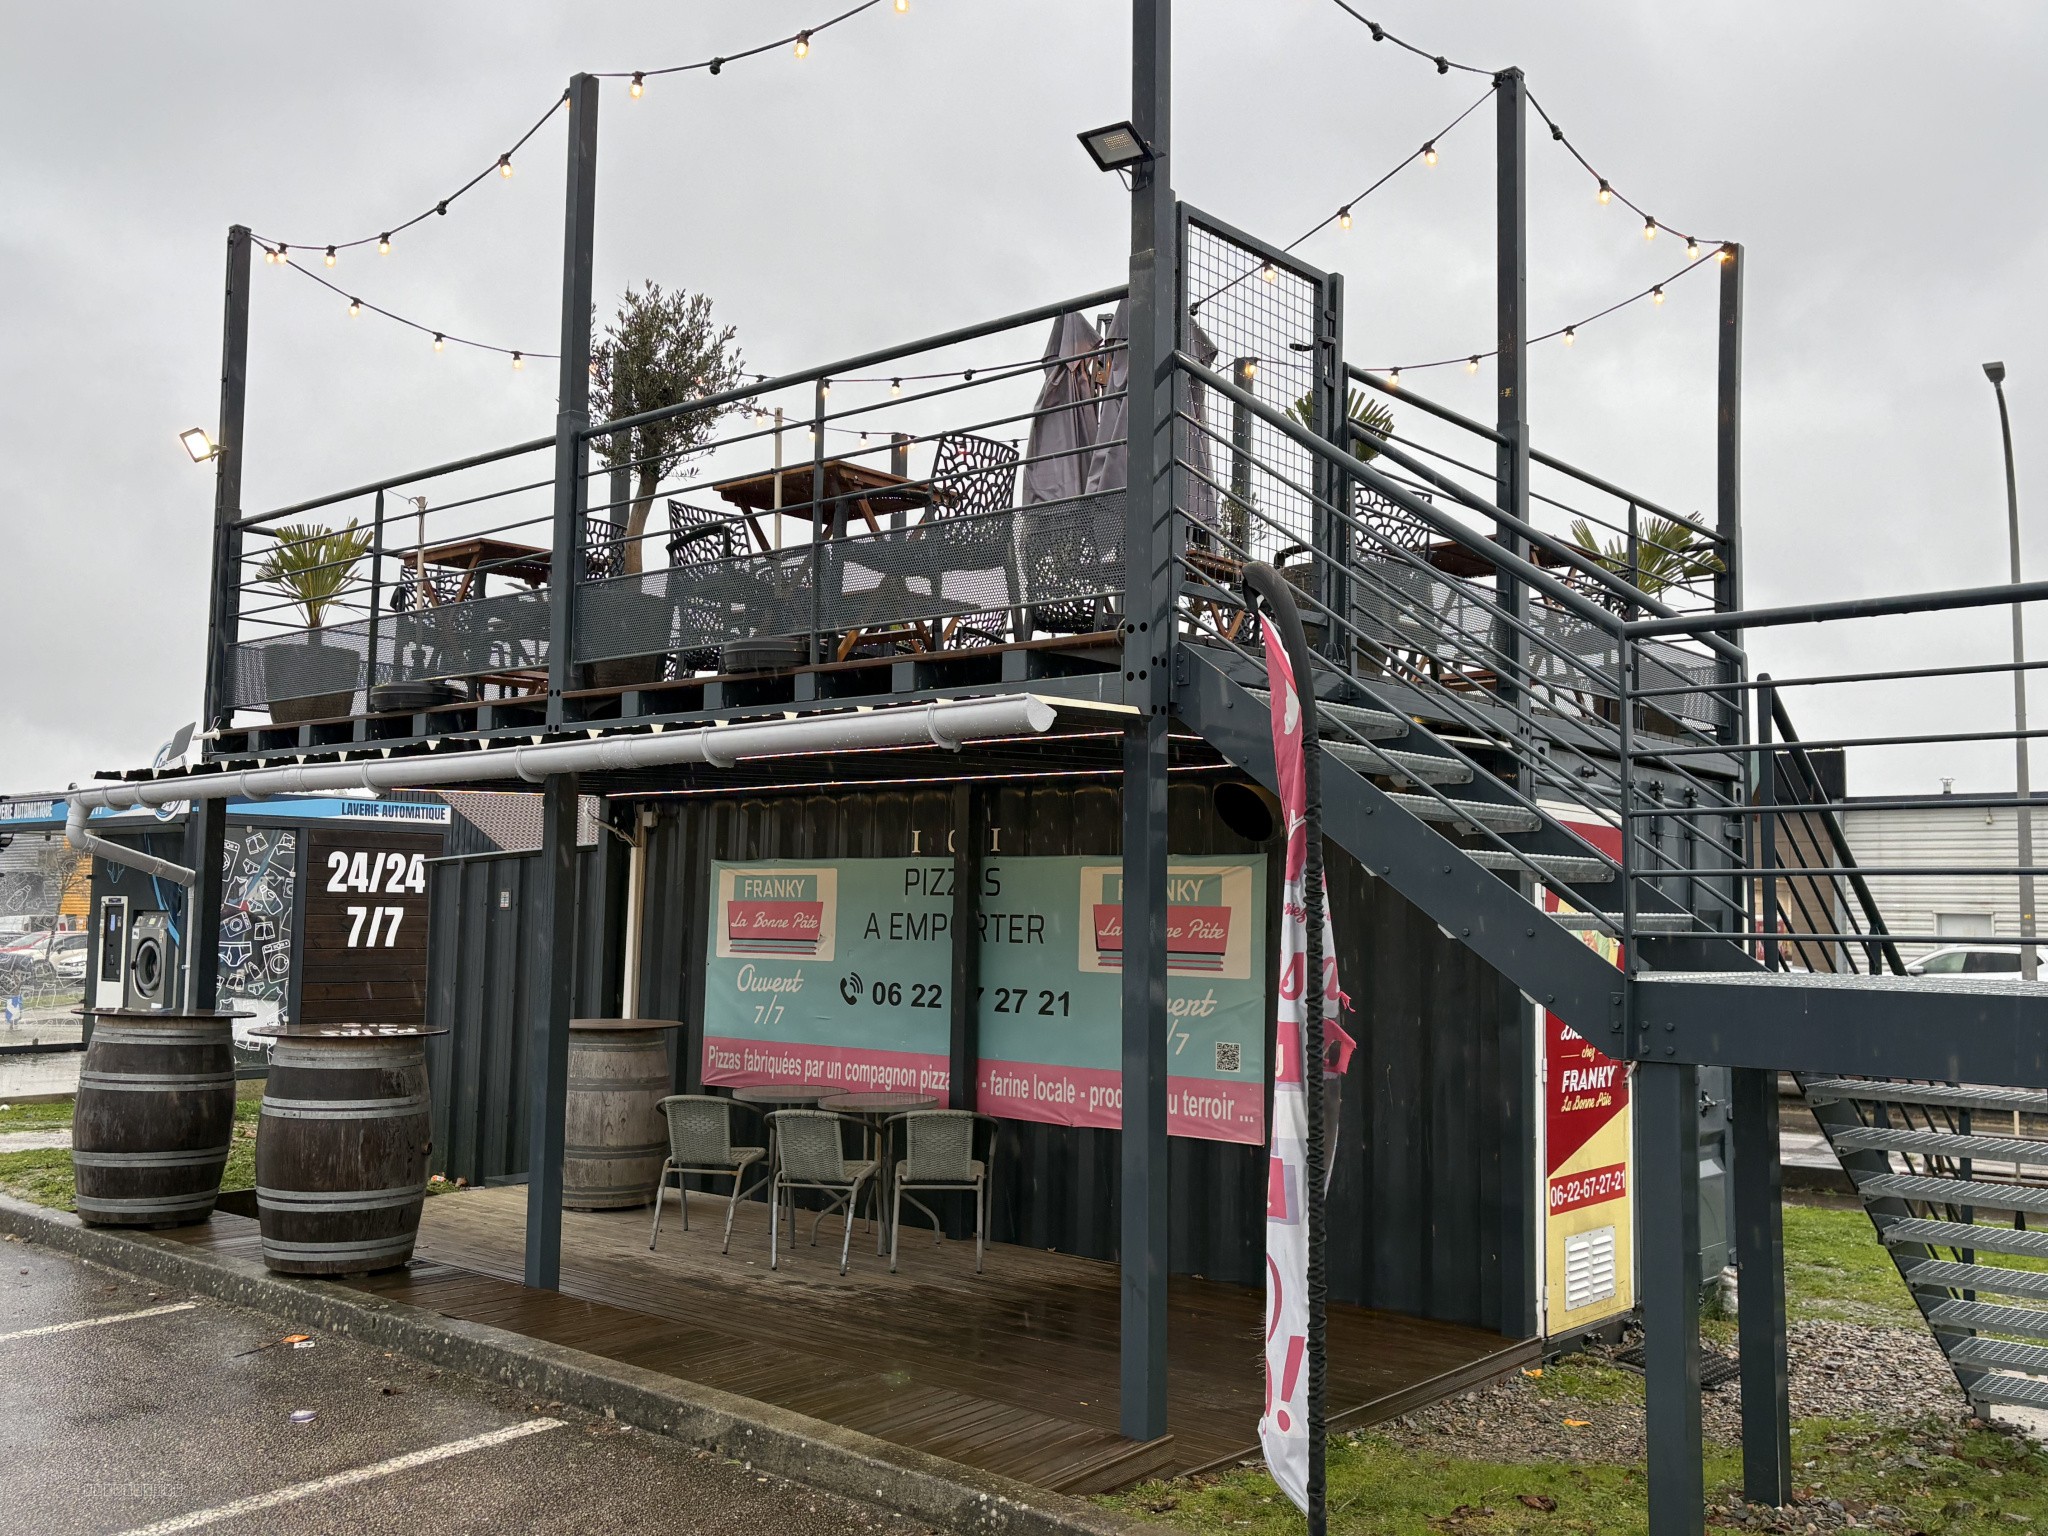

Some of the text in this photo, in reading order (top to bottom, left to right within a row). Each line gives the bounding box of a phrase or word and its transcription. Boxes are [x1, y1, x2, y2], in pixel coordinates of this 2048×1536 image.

[14, 801, 53, 818] AUTOMATIQUE
[341, 802, 446, 820] LAVERIE AUTOMATIQUE
[326, 850, 426, 894] 24/24
[904, 867, 1001, 897] PIZS
[744, 879, 805, 898] FRANKY
[347, 906, 404, 948] 7/7
[731, 911, 819, 929] La Bonne Pâte
[863, 912, 1045, 944] A EMPRTER
[1098, 917, 1122, 936] La
[1188, 919, 1225, 939] Pâte
[737, 963, 804, 993] Ouvert
[754, 994, 785, 1025] 7/7
[872, 981, 902, 1006] 06
[910, 983, 943, 1009] 22
[993, 987, 1028, 1014] 27
[1037, 990, 1070, 1017] 21
[708, 1045, 741, 1070] Pizzas
[744, 1048, 802, 1079] fabriquées
[804, 1058, 824, 1082] par
[827, 1060, 842, 1079] un
[844, 1062, 917, 1091] compagnon
[990, 1069, 1030, 1098] farine
[1033, 1076, 1076, 1104] locale
[1182, 1089, 1235, 1121] terroir
[1561, 1065, 1615, 1094] FRANKY
[1561, 1096, 1572, 1113] La
[1572, 1095, 1596, 1111] Bonne
[1550, 1170, 1625, 1207] 06-22-67-27-21
